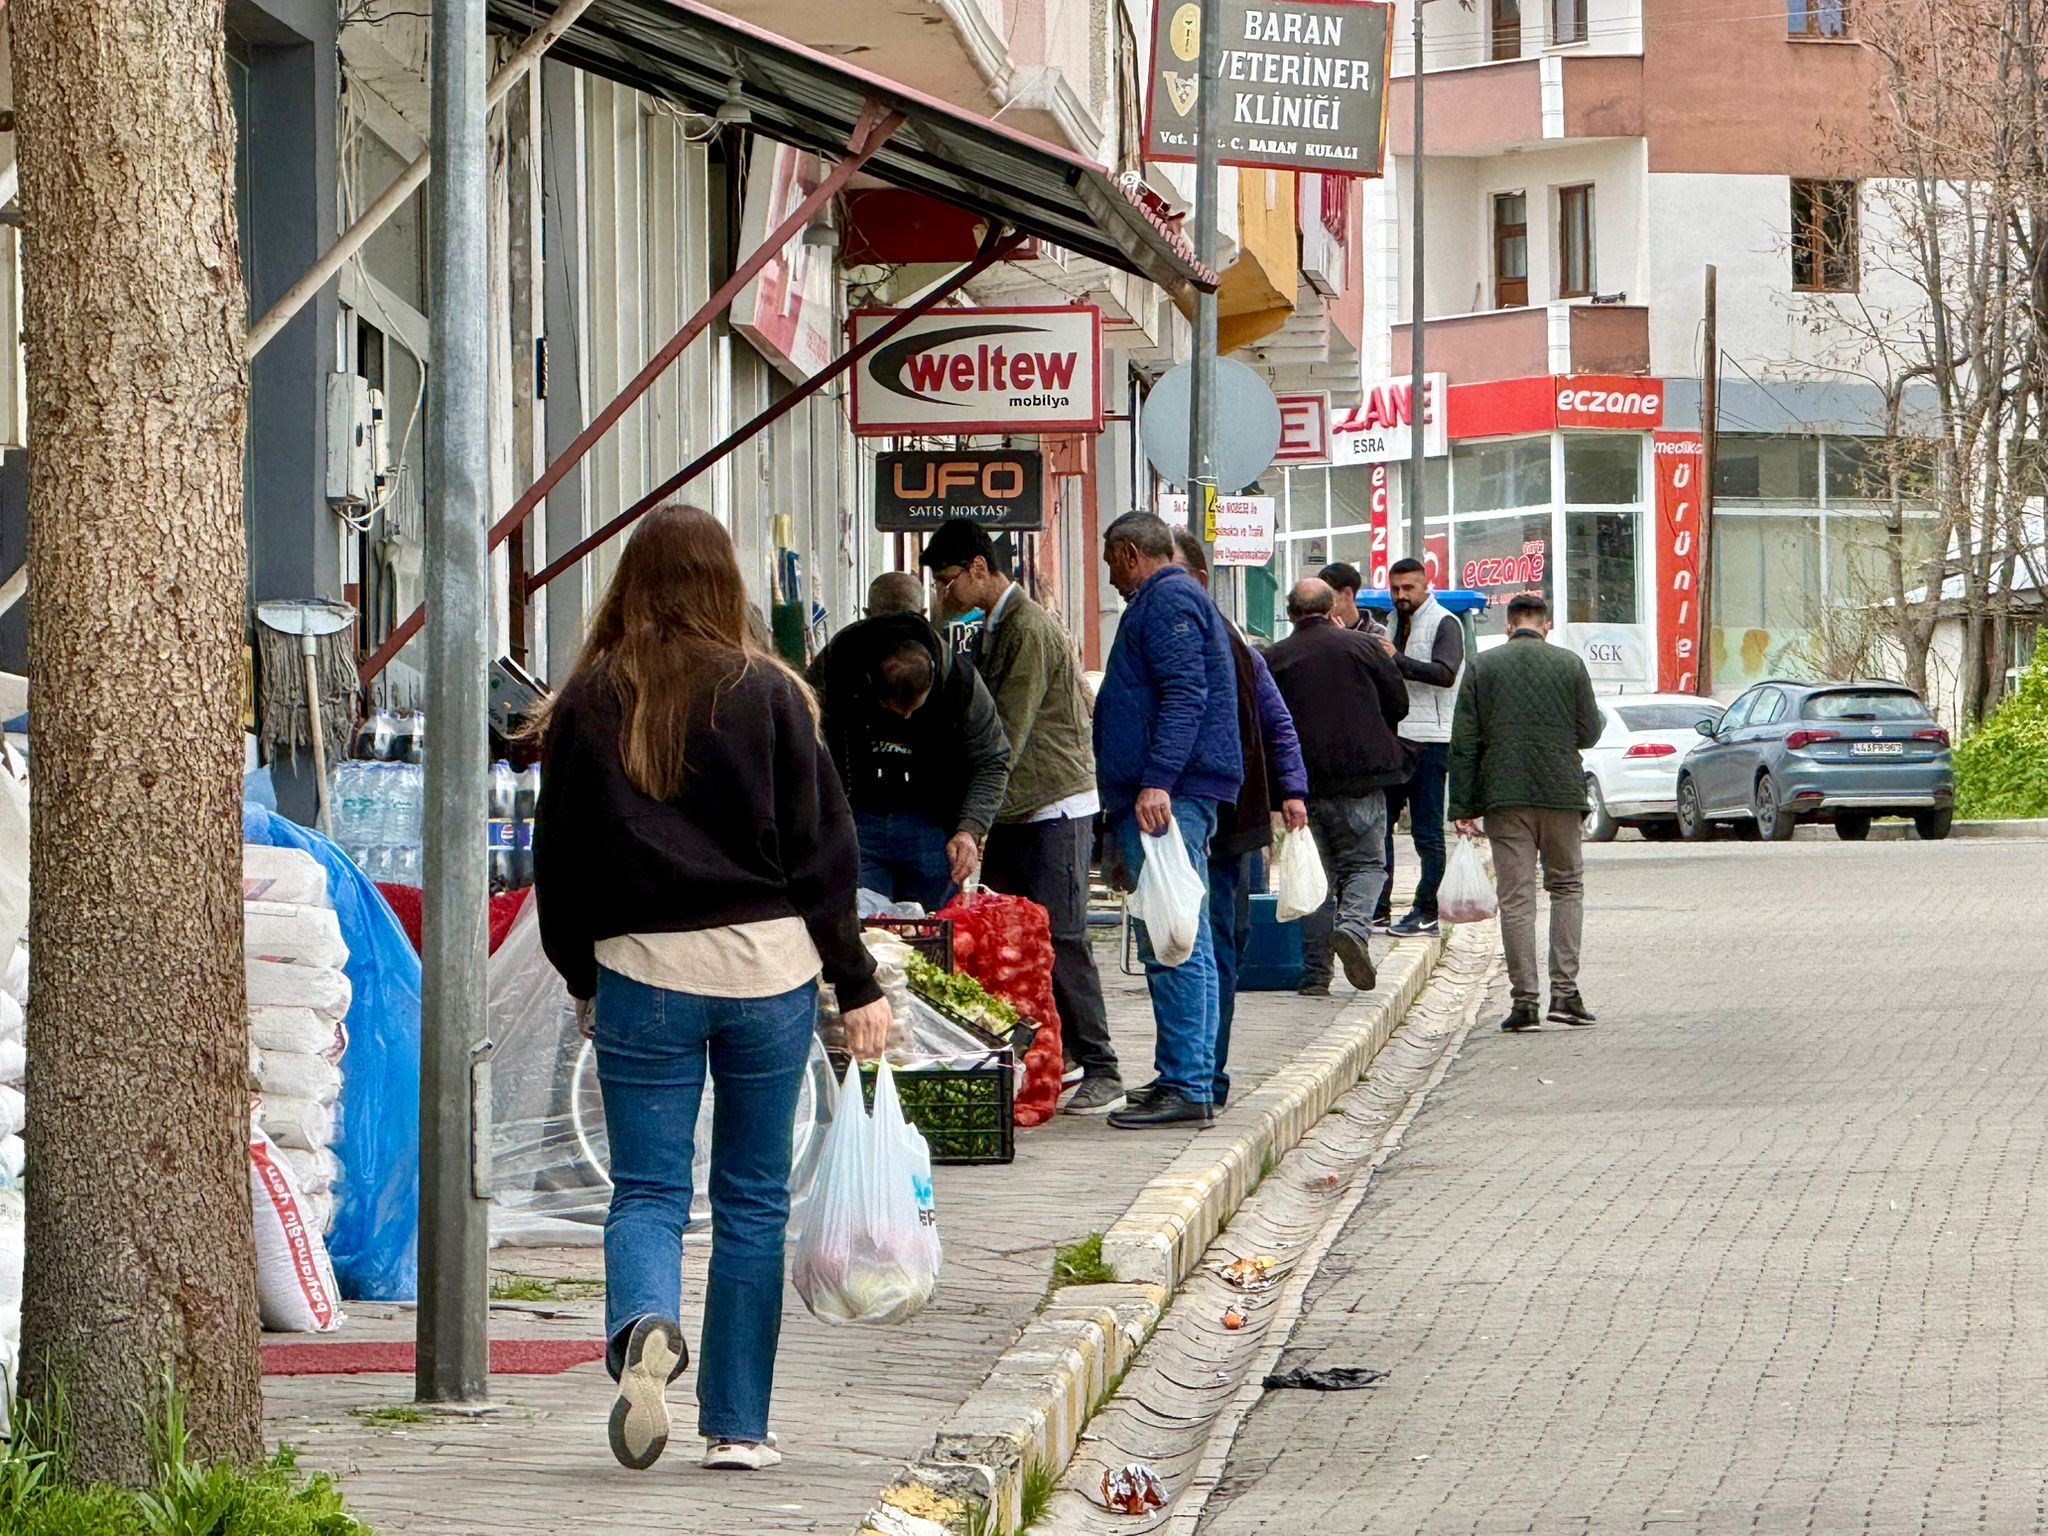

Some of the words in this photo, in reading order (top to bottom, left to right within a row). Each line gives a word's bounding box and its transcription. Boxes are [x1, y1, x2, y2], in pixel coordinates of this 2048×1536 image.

[1244, 9, 1343, 47] BARAN
[1233, 91, 1341, 131] KLİNİĞİ
[1160, 131, 1187, 145] Vet.
[1305, 143, 1359, 160] KULALI
[906, 344, 1077, 391] weltew
[1009, 394, 1069, 408] mobilya
[1557, 388, 1659, 415] eczane
[1353, 438, 1385, 454] ESRA
[1653, 441, 1704, 455] medika
[893, 462, 1024, 499] UFO
[1463, 554, 1545, 588] eczane
[1589, 644, 1623, 661] SGK
[266, 1165, 292, 1205] yem
[284, 1210, 328, 1314] bayramoğlu
